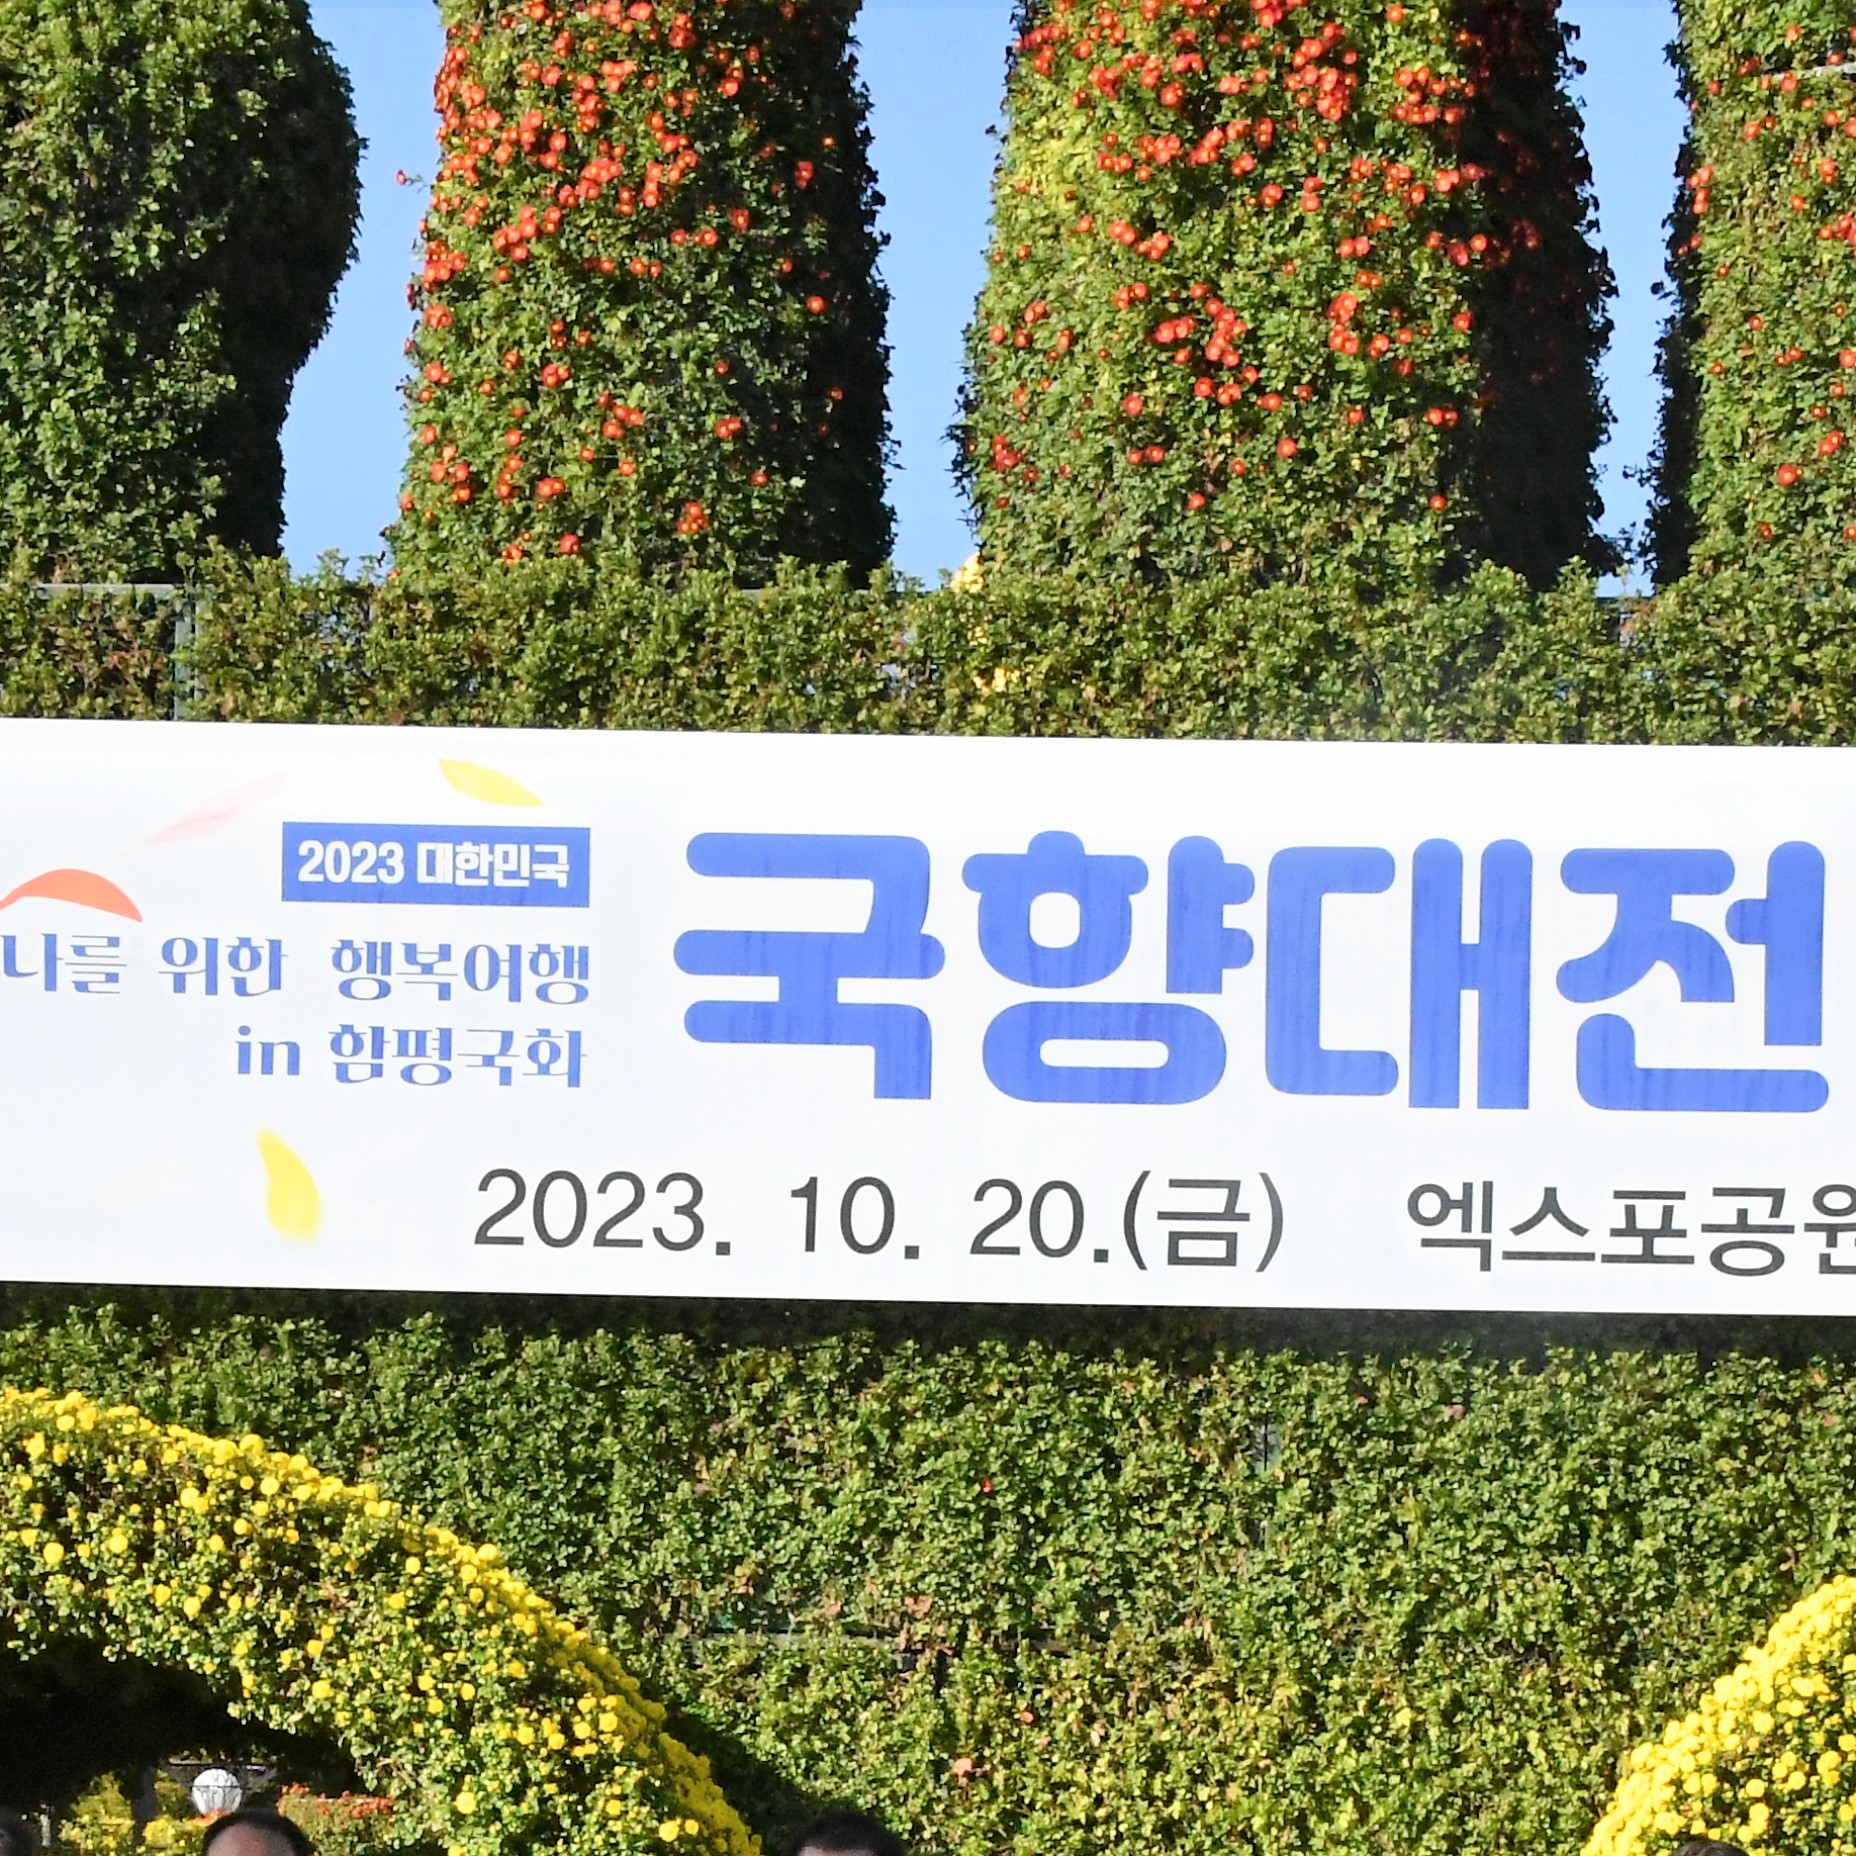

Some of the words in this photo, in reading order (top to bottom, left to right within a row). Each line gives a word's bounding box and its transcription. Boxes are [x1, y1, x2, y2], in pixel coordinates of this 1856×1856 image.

[297, 840, 405, 885] 2023
[415, 839, 571, 889] 대한민국
[0, 932, 127, 995] 나를
[158, 936, 289, 997] 위한
[331, 938, 590, 1004] 행복여행
[672, 830, 1830, 1115] 국향대전
[235, 1025, 301, 1077] in
[329, 1024, 587, 1089] 함평국화
[474, 1168, 732, 1256] 2023.
[790, 1176, 920, 1260] 10.
[970, 1170, 1284, 1273] 20.(금)
